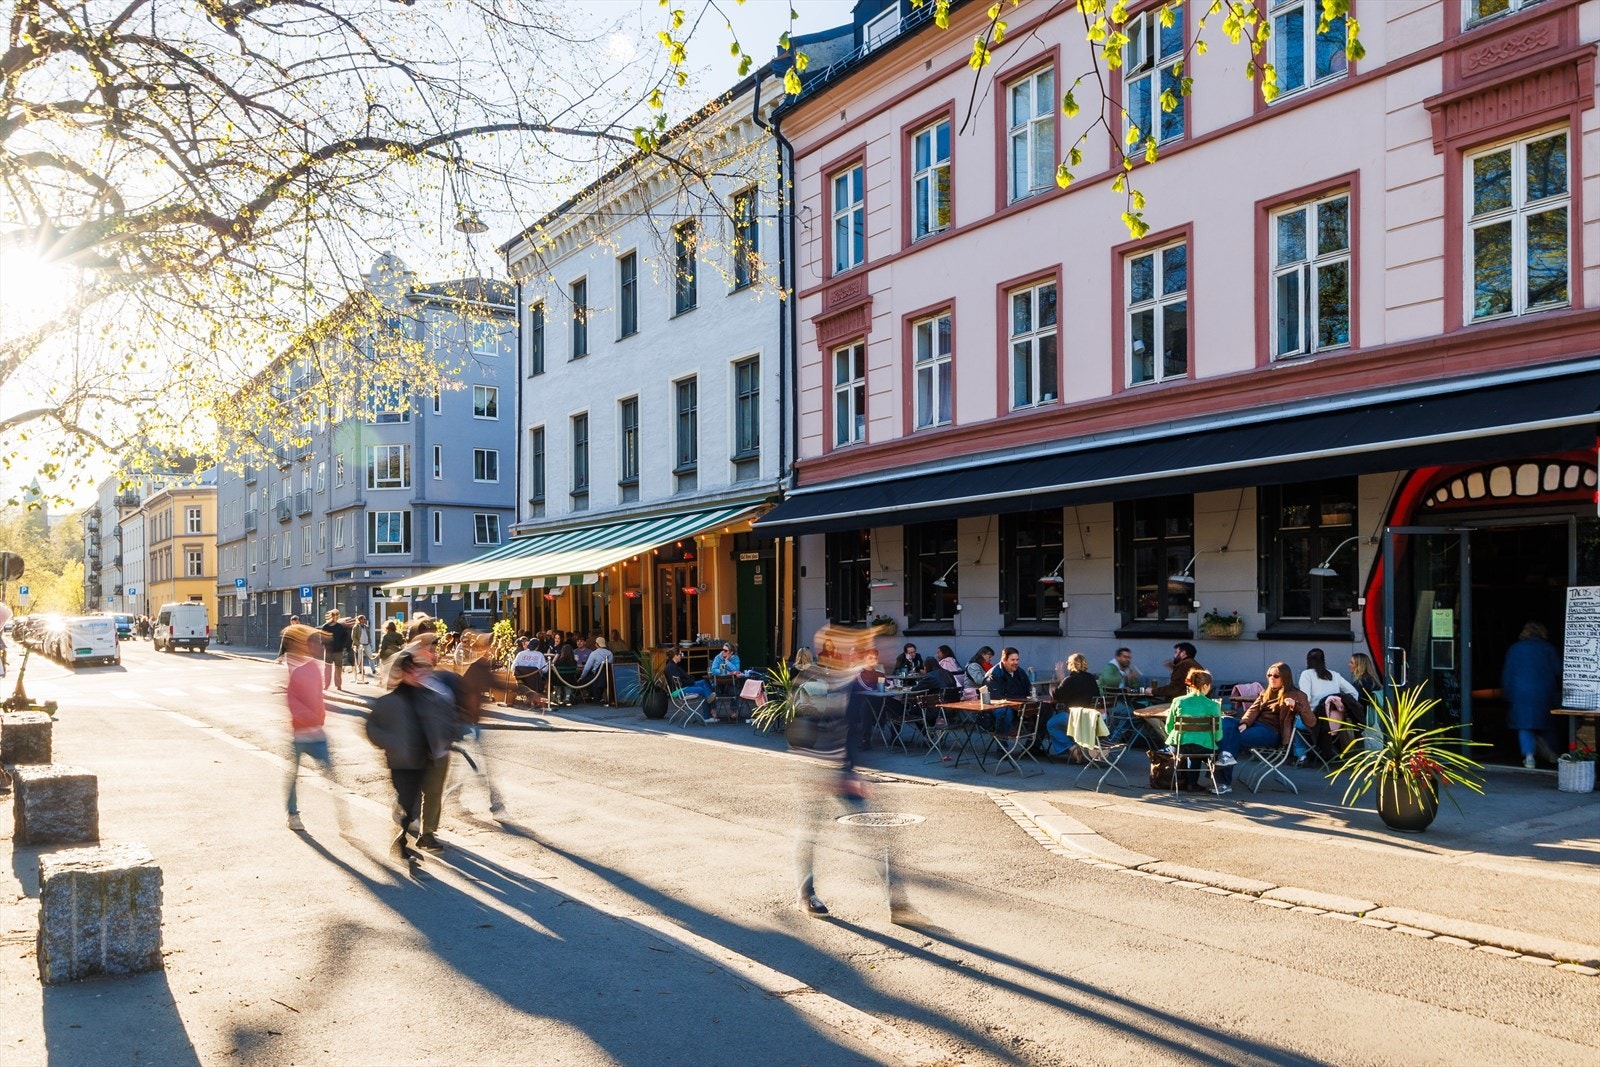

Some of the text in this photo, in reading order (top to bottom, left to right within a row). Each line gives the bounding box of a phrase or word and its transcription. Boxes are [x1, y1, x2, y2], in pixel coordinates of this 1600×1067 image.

[237, 579, 243, 587] P
[303, 587, 310, 597] P
[1569, 588, 1592, 598] TACOS
